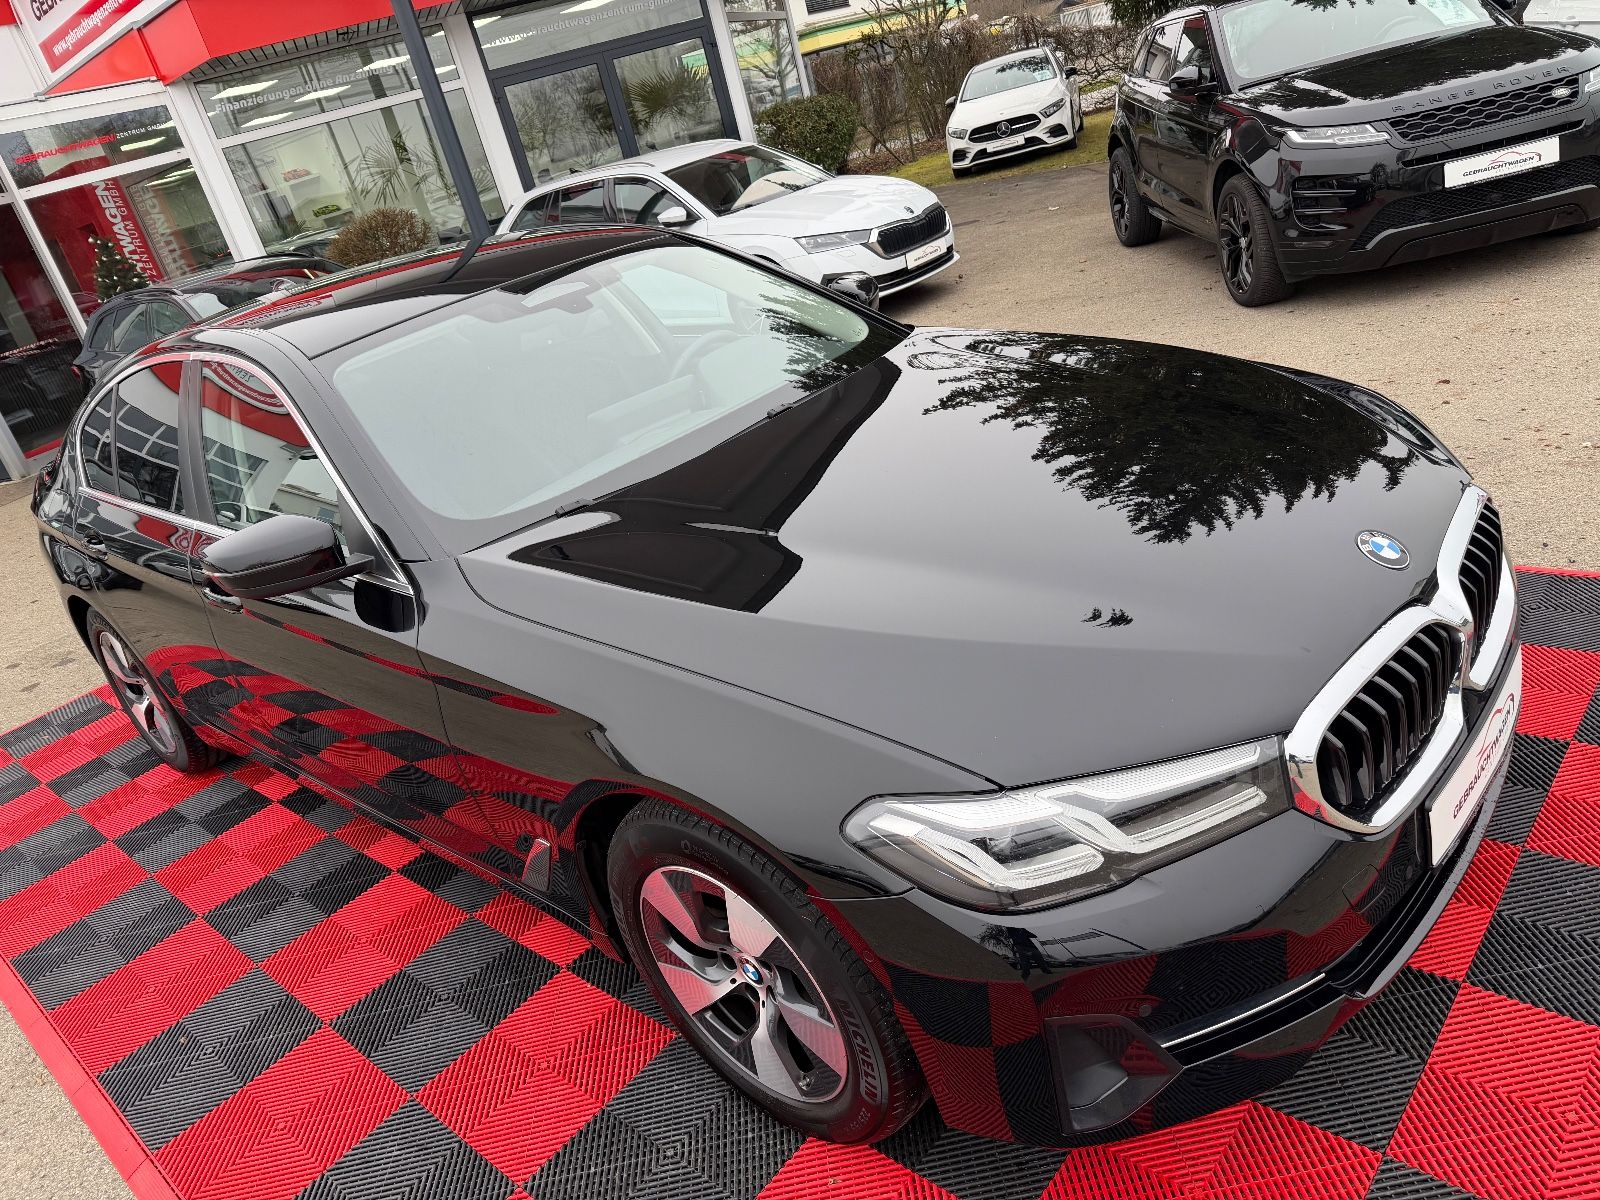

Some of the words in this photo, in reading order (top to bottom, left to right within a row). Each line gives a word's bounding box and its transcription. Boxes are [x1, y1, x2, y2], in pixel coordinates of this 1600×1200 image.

[215, 86, 304, 112] Finanzierungen
[1391, 88, 1476, 113] RANGE
[1493, 65, 1572, 90] ROVER
[104, 180, 128, 216] GMBH
[123, 220, 157, 276] ZENTRUM
[1453, 703, 1511, 820] GEBRAUCHTWAGEN
[838, 999, 878, 1101] MICHELIN
